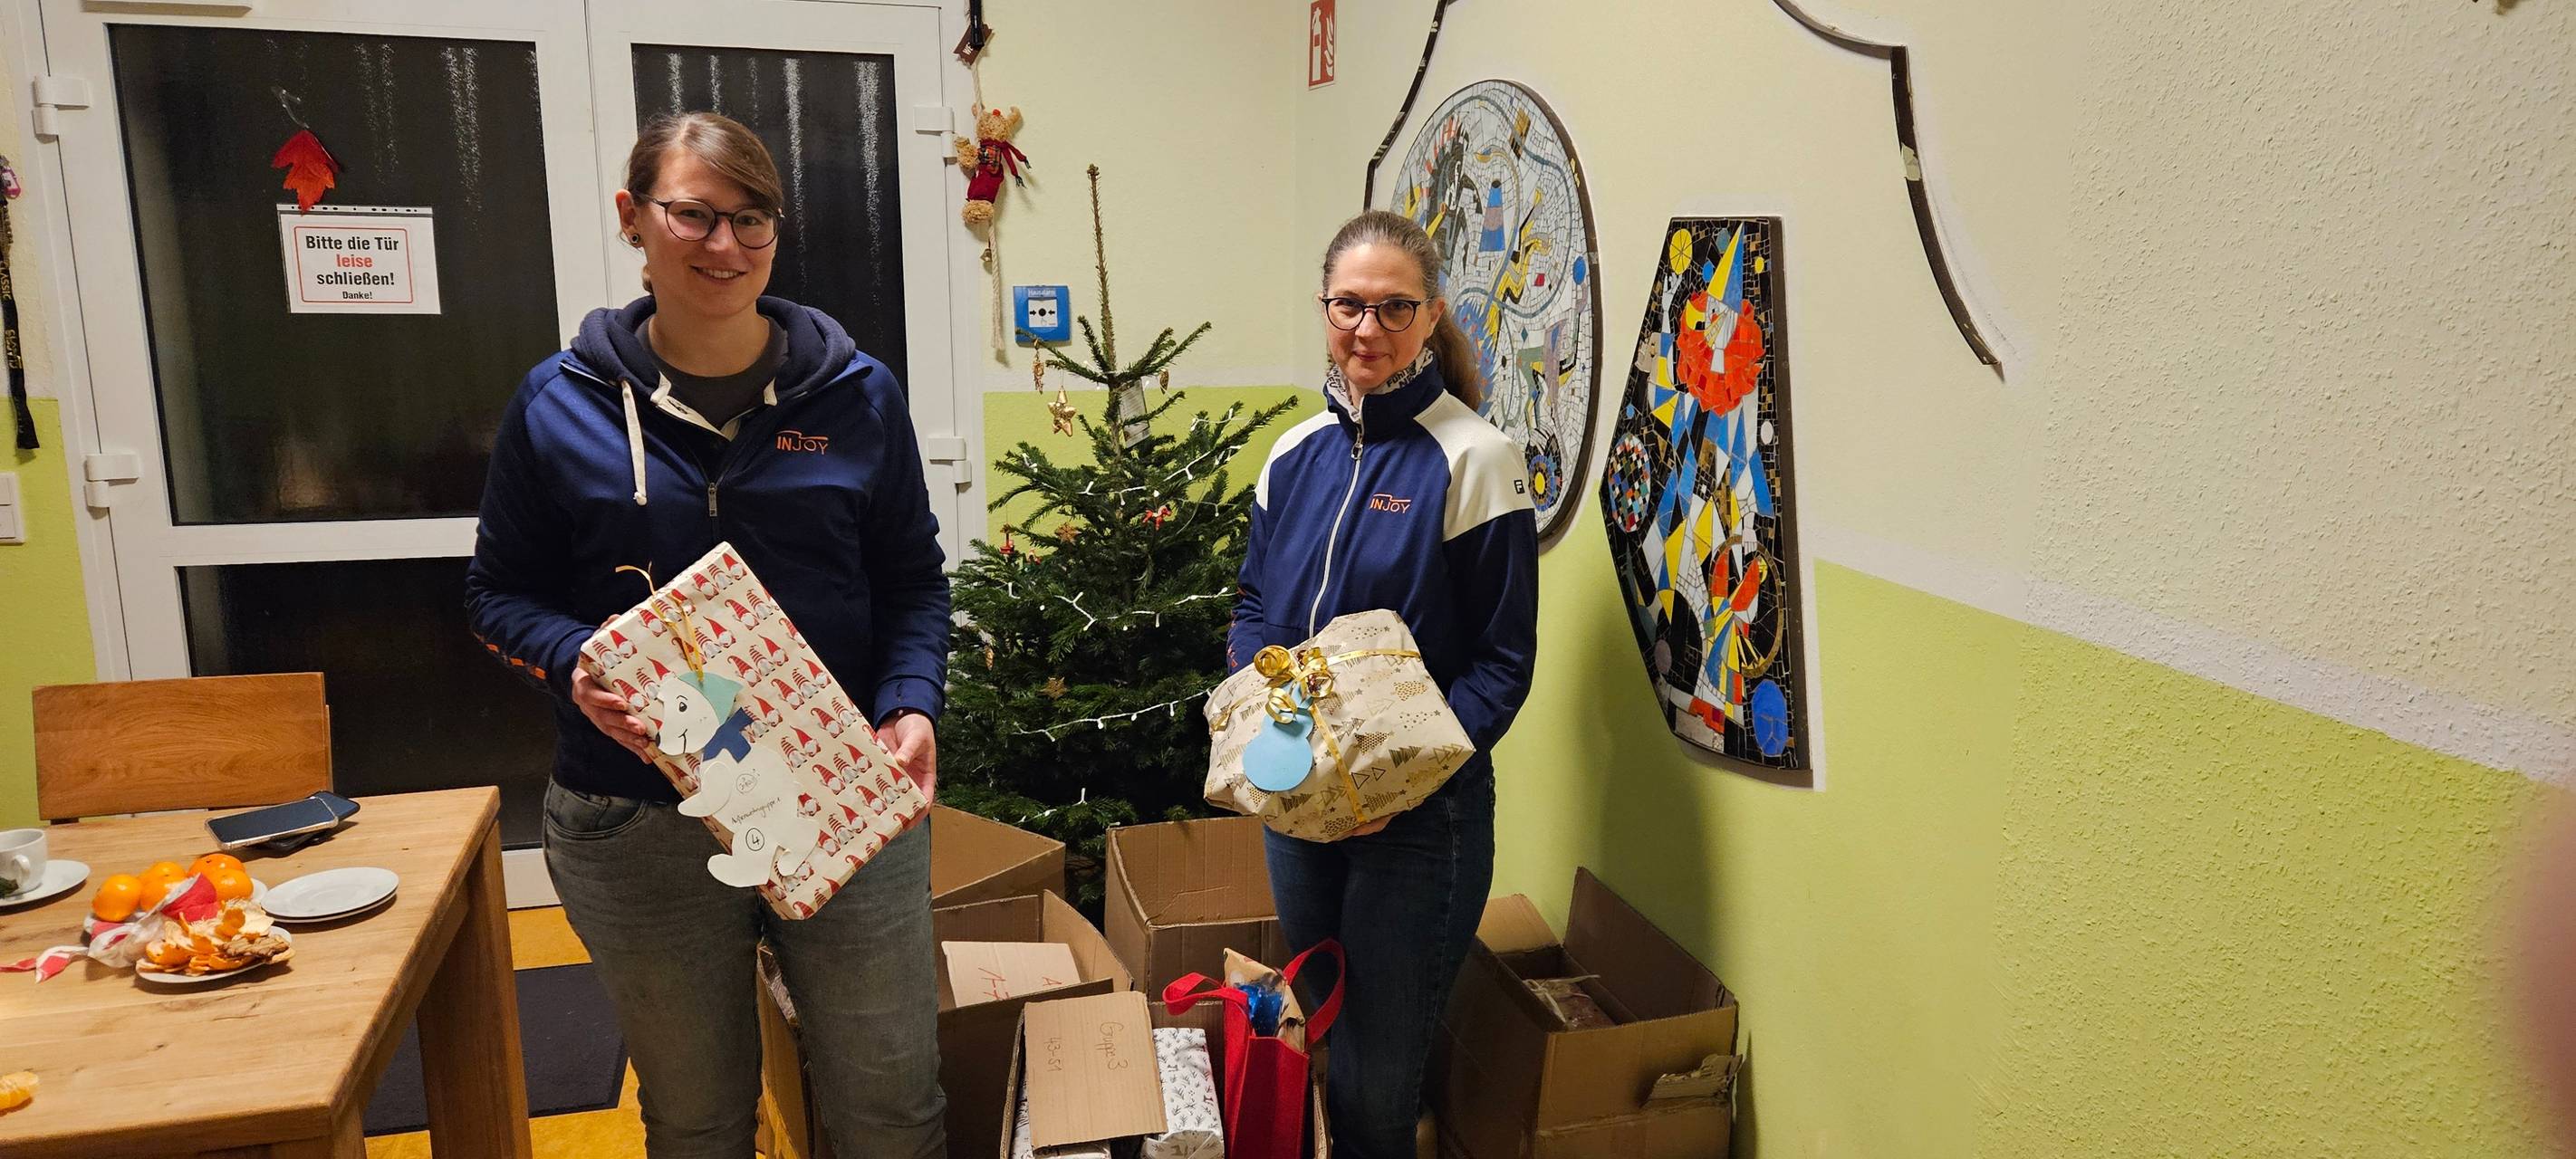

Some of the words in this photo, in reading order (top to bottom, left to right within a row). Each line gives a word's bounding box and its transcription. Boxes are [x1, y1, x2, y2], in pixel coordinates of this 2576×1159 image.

[305, 235, 342, 250] Bitte
[347, 236, 370, 250] die
[374, 236, 399, 251] Tür
[336, 254, 373, 268] leise
[317, 272, 395, 285] schließen!
[342, 291, 373, 300] Danke!
[776, 432, 829, 455] INJOY
[1370, 494, 1411, 513] INJOY
[751, 833, 760, 846] 4
[1043, 1037, 1062, 1072] 43-51
[1108, 1058, 1129, 1070] 3
